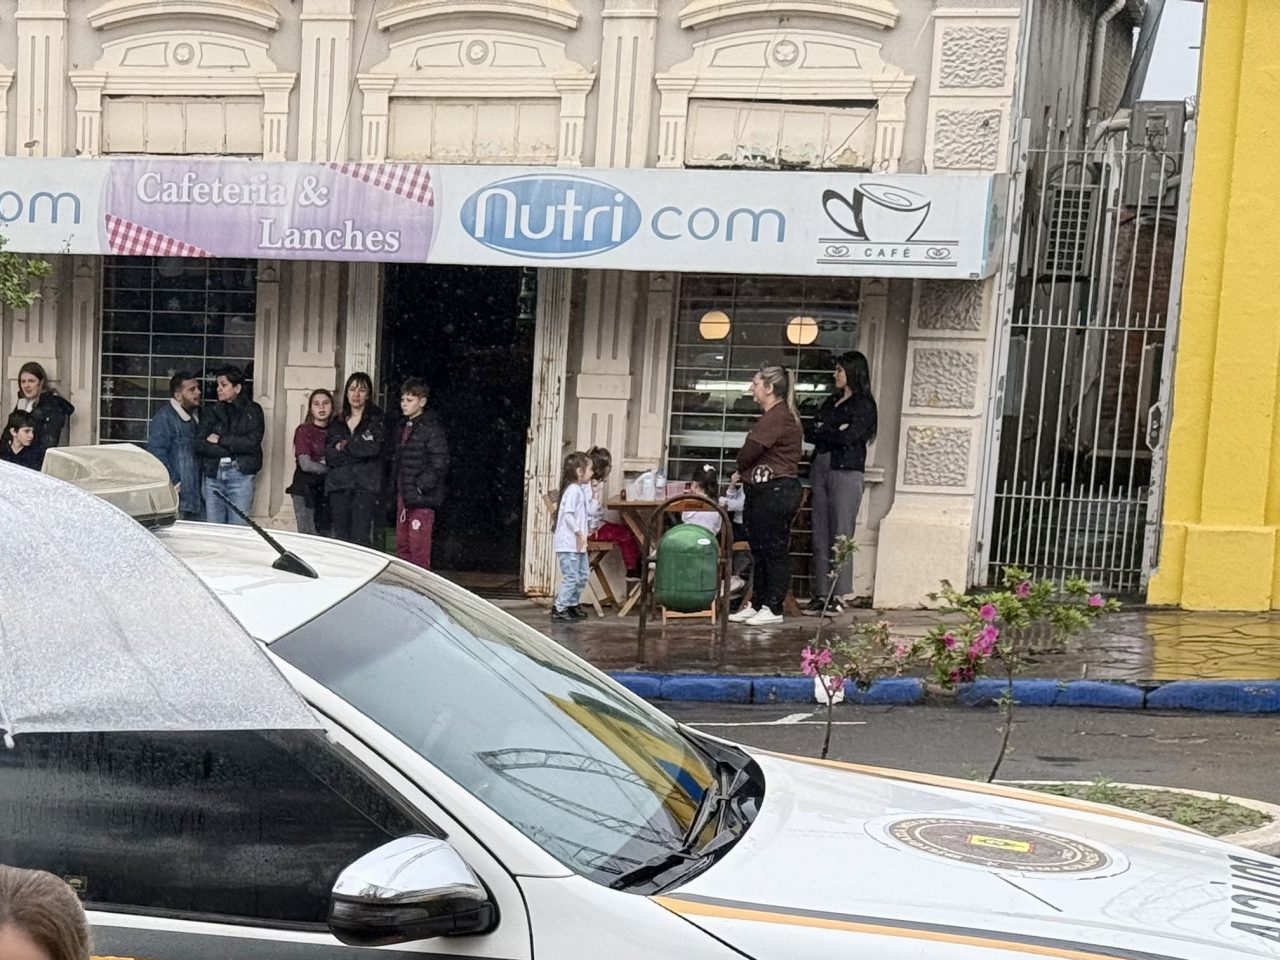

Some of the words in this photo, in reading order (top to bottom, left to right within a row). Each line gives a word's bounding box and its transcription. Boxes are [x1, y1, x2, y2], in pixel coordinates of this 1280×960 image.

[136, 171, 288, 207] Cafeteria
[298, 175, 330, 207] &
[258, 218, 402, 252] Lanches
[651, 206, 787, 243] com
[864, 247, 912, 258] CAFÉ
